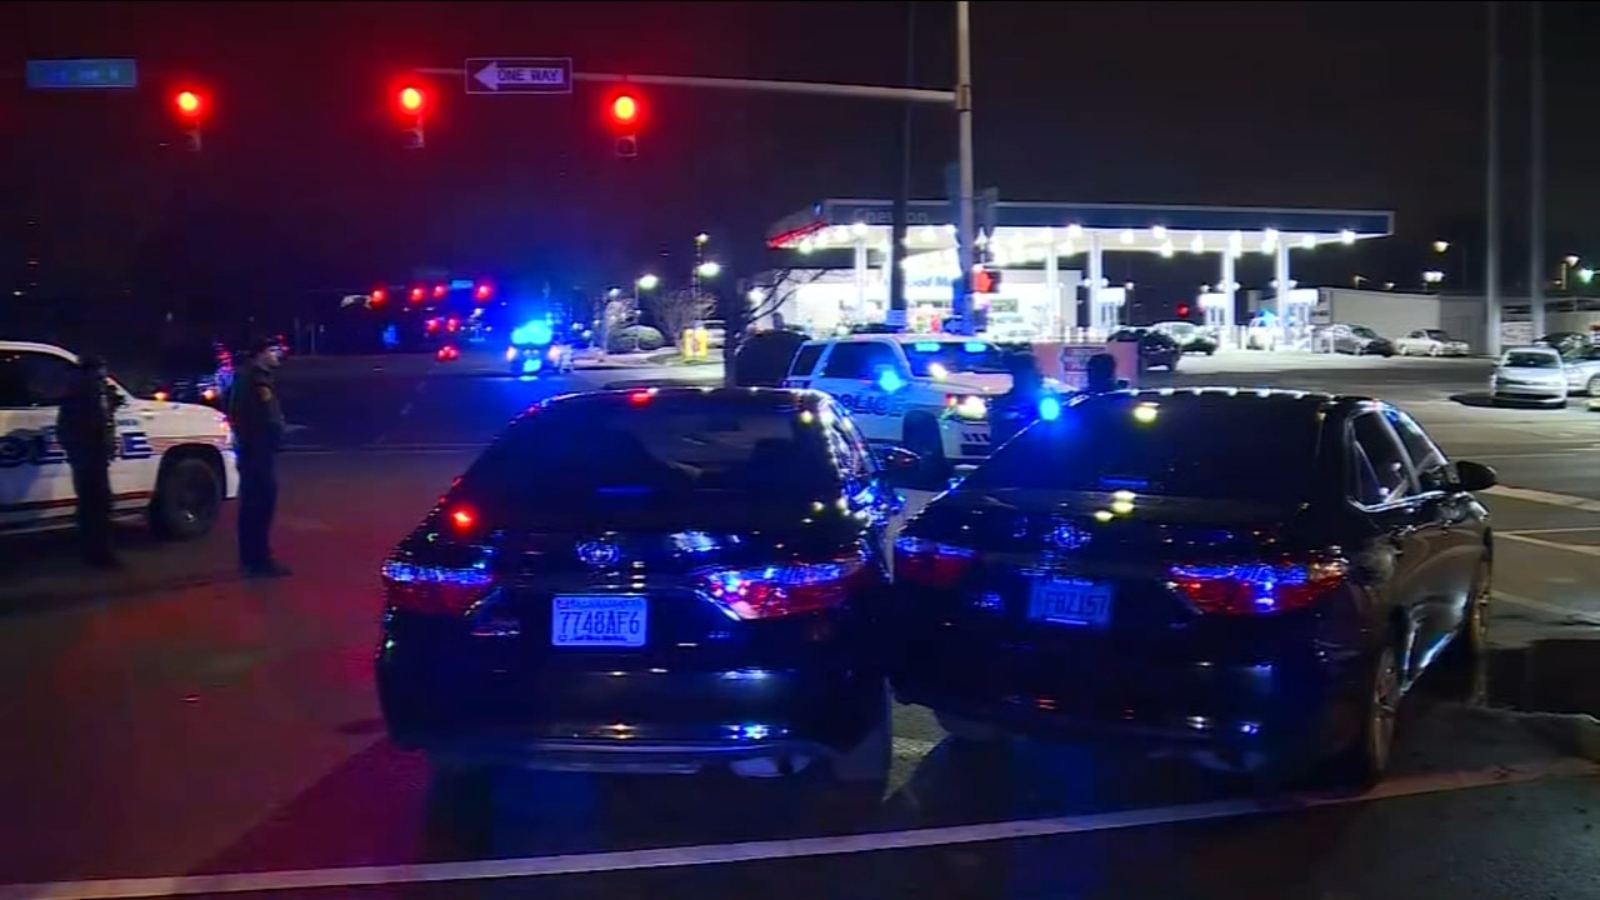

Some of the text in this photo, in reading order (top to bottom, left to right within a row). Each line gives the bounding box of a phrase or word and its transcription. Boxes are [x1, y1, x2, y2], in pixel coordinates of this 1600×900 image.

[497, 69, 558, 82] ONE WAY
[853, 207, 929, 223] Cheon
[558, 609, 642, 635] 7748AF6
